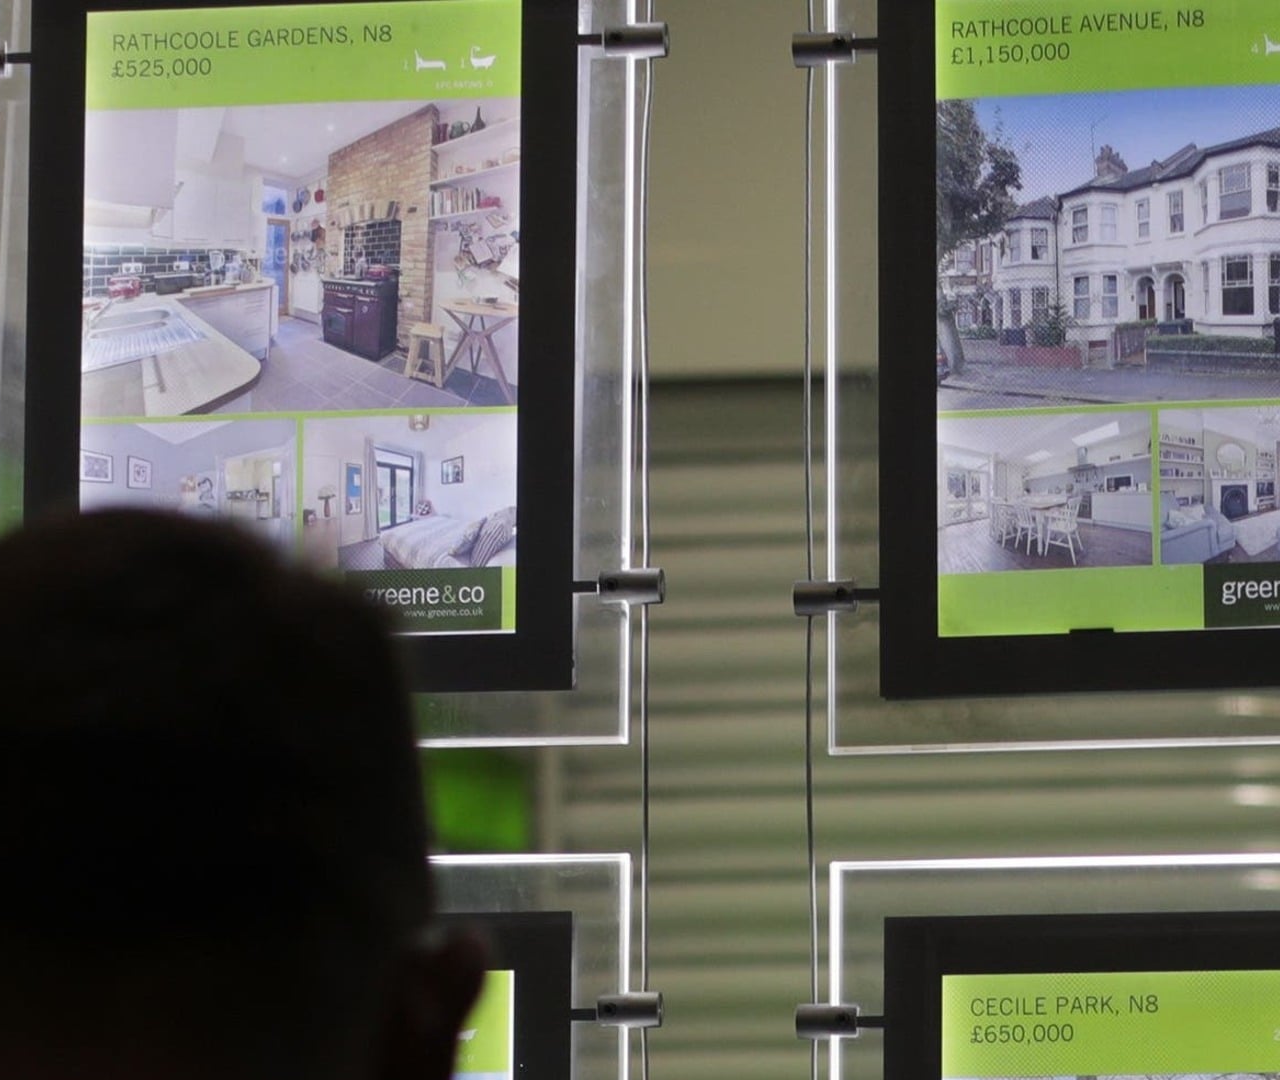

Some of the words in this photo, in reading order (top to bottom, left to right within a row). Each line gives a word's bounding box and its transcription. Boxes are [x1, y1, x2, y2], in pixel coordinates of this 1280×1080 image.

[951, 15, 1073, 39] RATHCOOLE
[1079, 10, 1168, 33] AVENUE,
[1177, 9, 1205, 28] N8
[112, 30, 240, 52] RATHCOOLE
[247, 25, 354, 48] GARDENS,
[363, 24, 393, 43] N8
[951, 42, 1070, 66] £1,150,000
[111, 57, 212, 79] £525,000
[970, 996, 1048, 1016] CECILE
[1055, 995, 1120, 1016] PARK,
[1129, 994, 1159, 1014] N8
[971, 1024, 1074, 1045] £650,000
